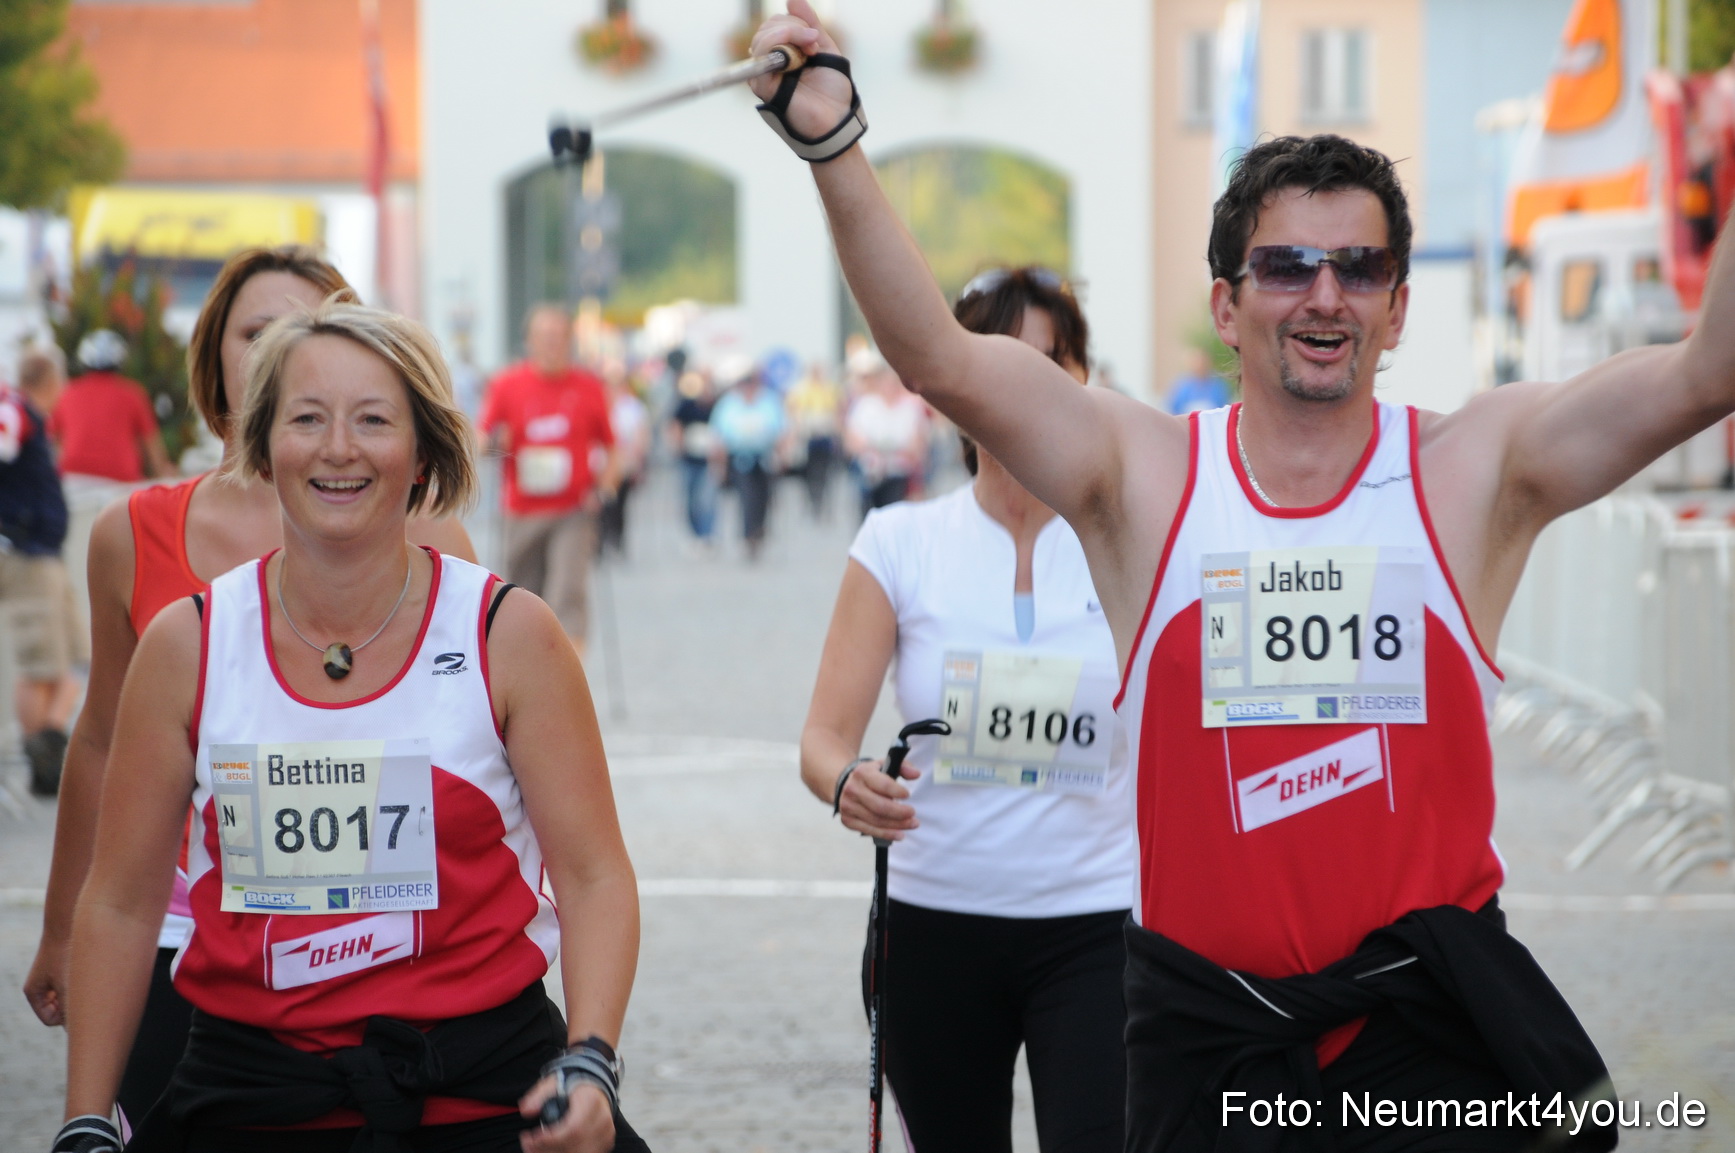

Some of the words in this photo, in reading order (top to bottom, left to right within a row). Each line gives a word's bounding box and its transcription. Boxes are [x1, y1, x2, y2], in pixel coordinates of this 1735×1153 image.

[1260, 559, 1343, 592] Jakob
[1211, 615, 1224, 639] N
[1265, 614, 1402, 662] 8018
[947, 697, 958, 717] N
[1226, 701, 1284, 717] BOCK
[1342, 695, 1423, 711] PFLEIDERER
[988, 704, 1096, 748] 8106
[267, 754, 366, 786] Bettina
[1280, 759, 1342, 802] DEHN
[223, 805, 236, 827] N
[274, 804, 410, 853] 8017
[244, 891, 296, 905] BOCK
[352, 883, 433, 899] PFLEIDERER
[352, 898, 434, 910] AKTIENGESELLSCHAFT
[308, 933, 374, 969] DEHN
